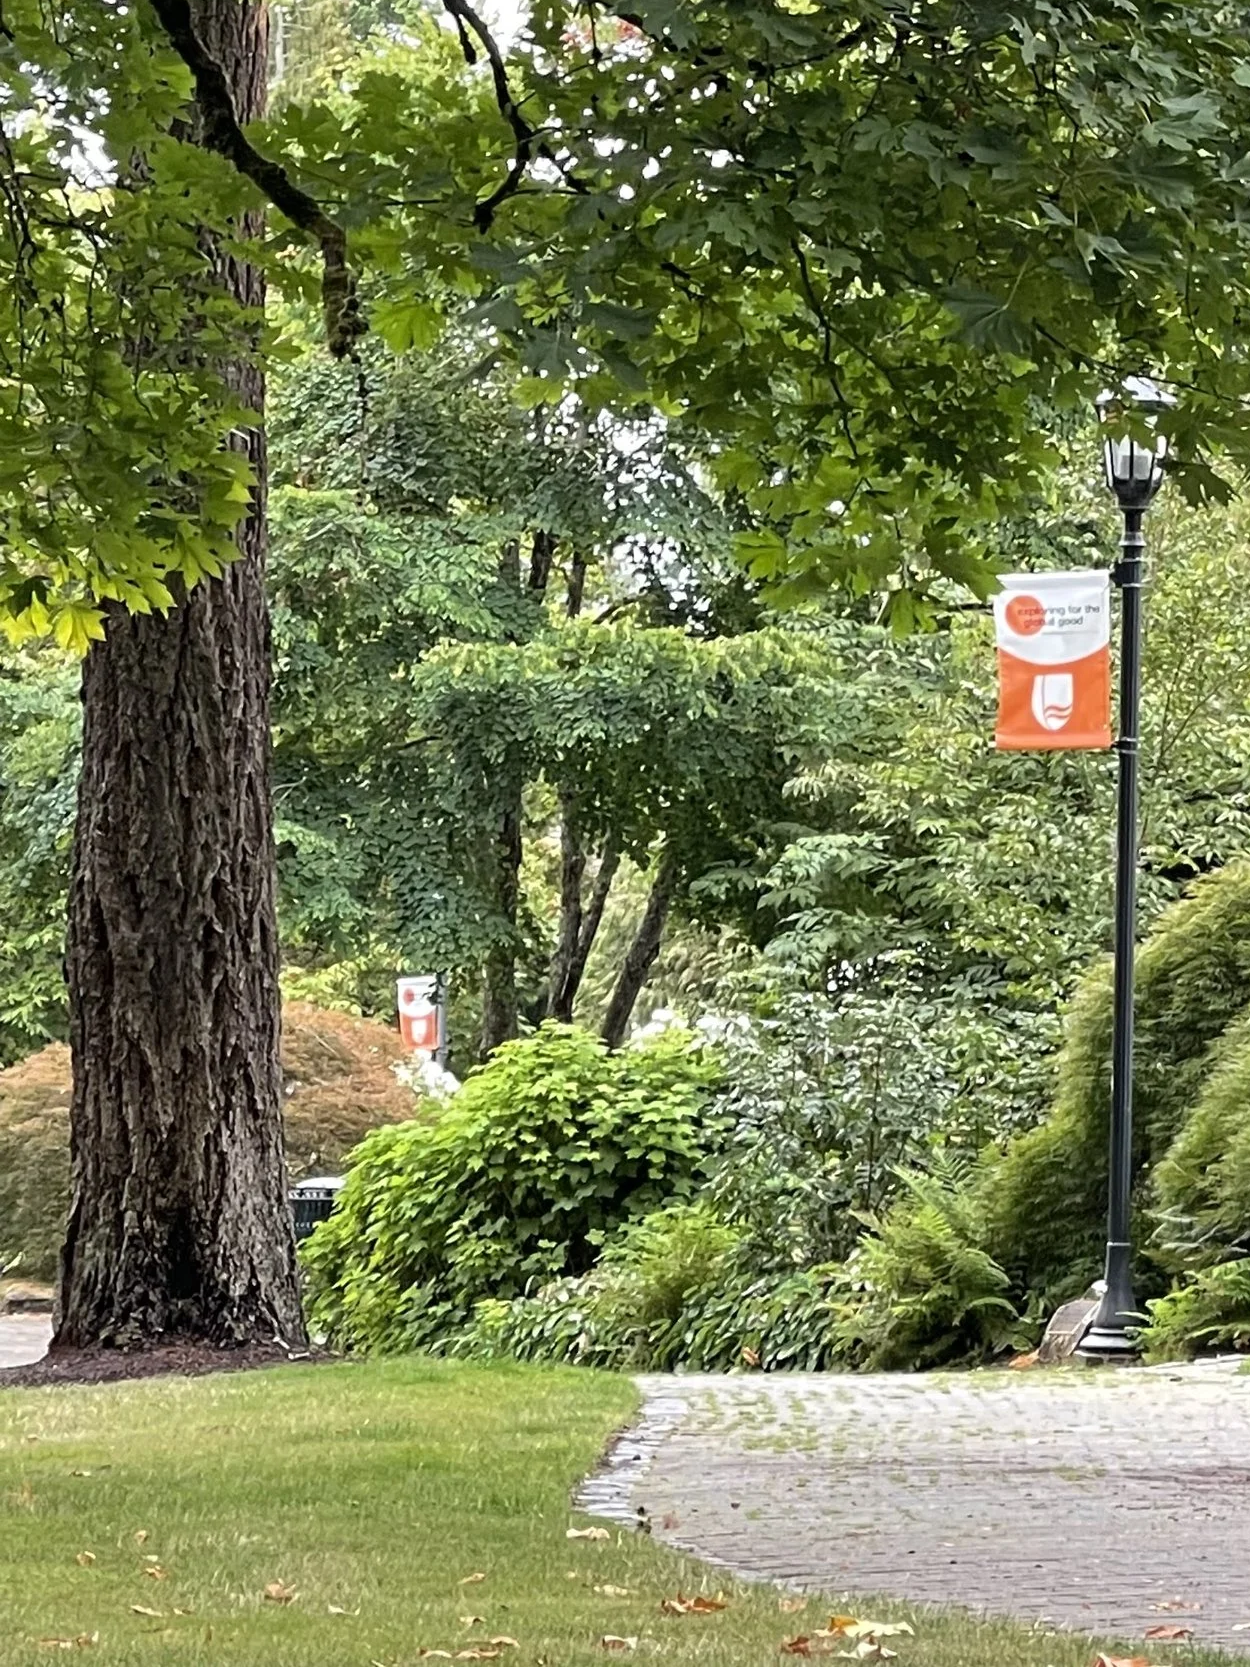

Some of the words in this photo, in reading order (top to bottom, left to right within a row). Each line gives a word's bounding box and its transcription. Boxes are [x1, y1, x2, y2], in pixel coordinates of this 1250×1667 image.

[1068, 605, 1082, 614] for
[1085, 605, 1100, 613] the
[1058, 616, 1083, 627] good
